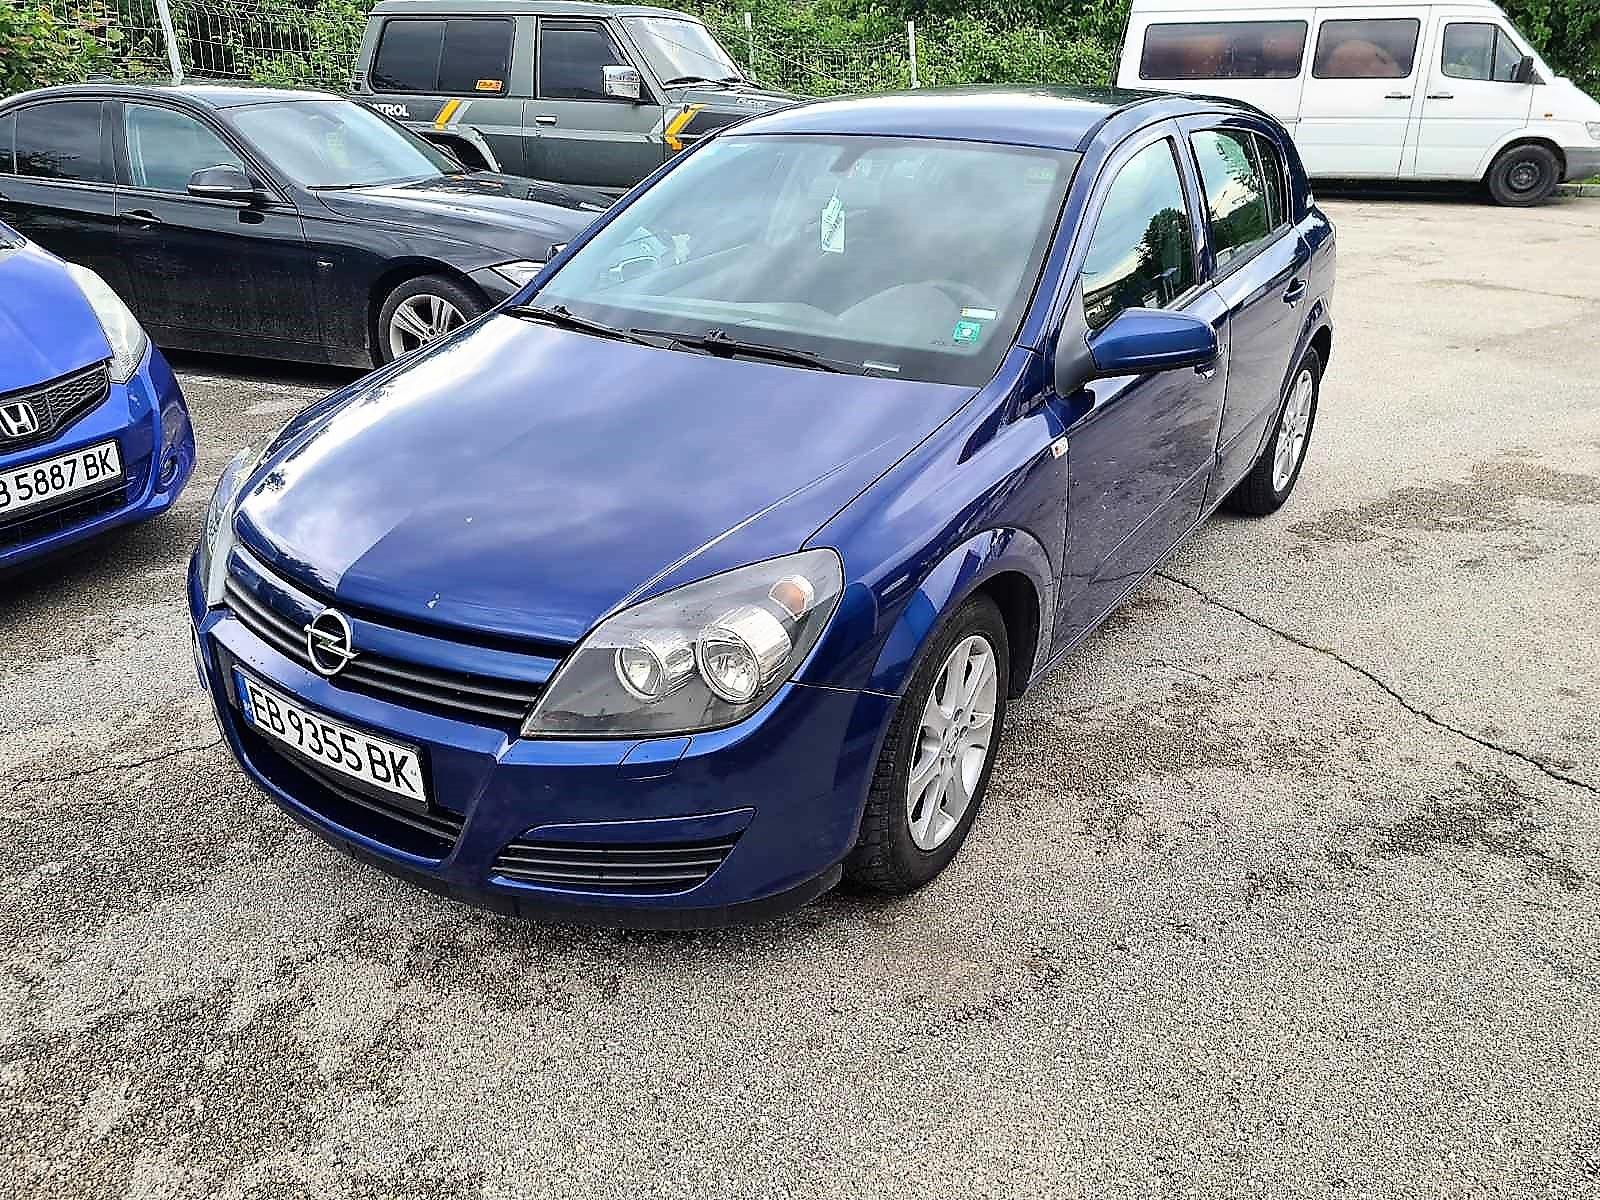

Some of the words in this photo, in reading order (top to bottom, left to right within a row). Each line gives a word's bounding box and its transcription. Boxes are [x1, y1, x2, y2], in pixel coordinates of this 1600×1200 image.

[368, 103, 410, 117] ATROL
[14, 459, 77, 501] 5887
[83, 447, 116, 480] BK
[249, 686, 286, 735] EB
[287, 709, 362, 771] 9355
[365, 742, 417, 793] BK
